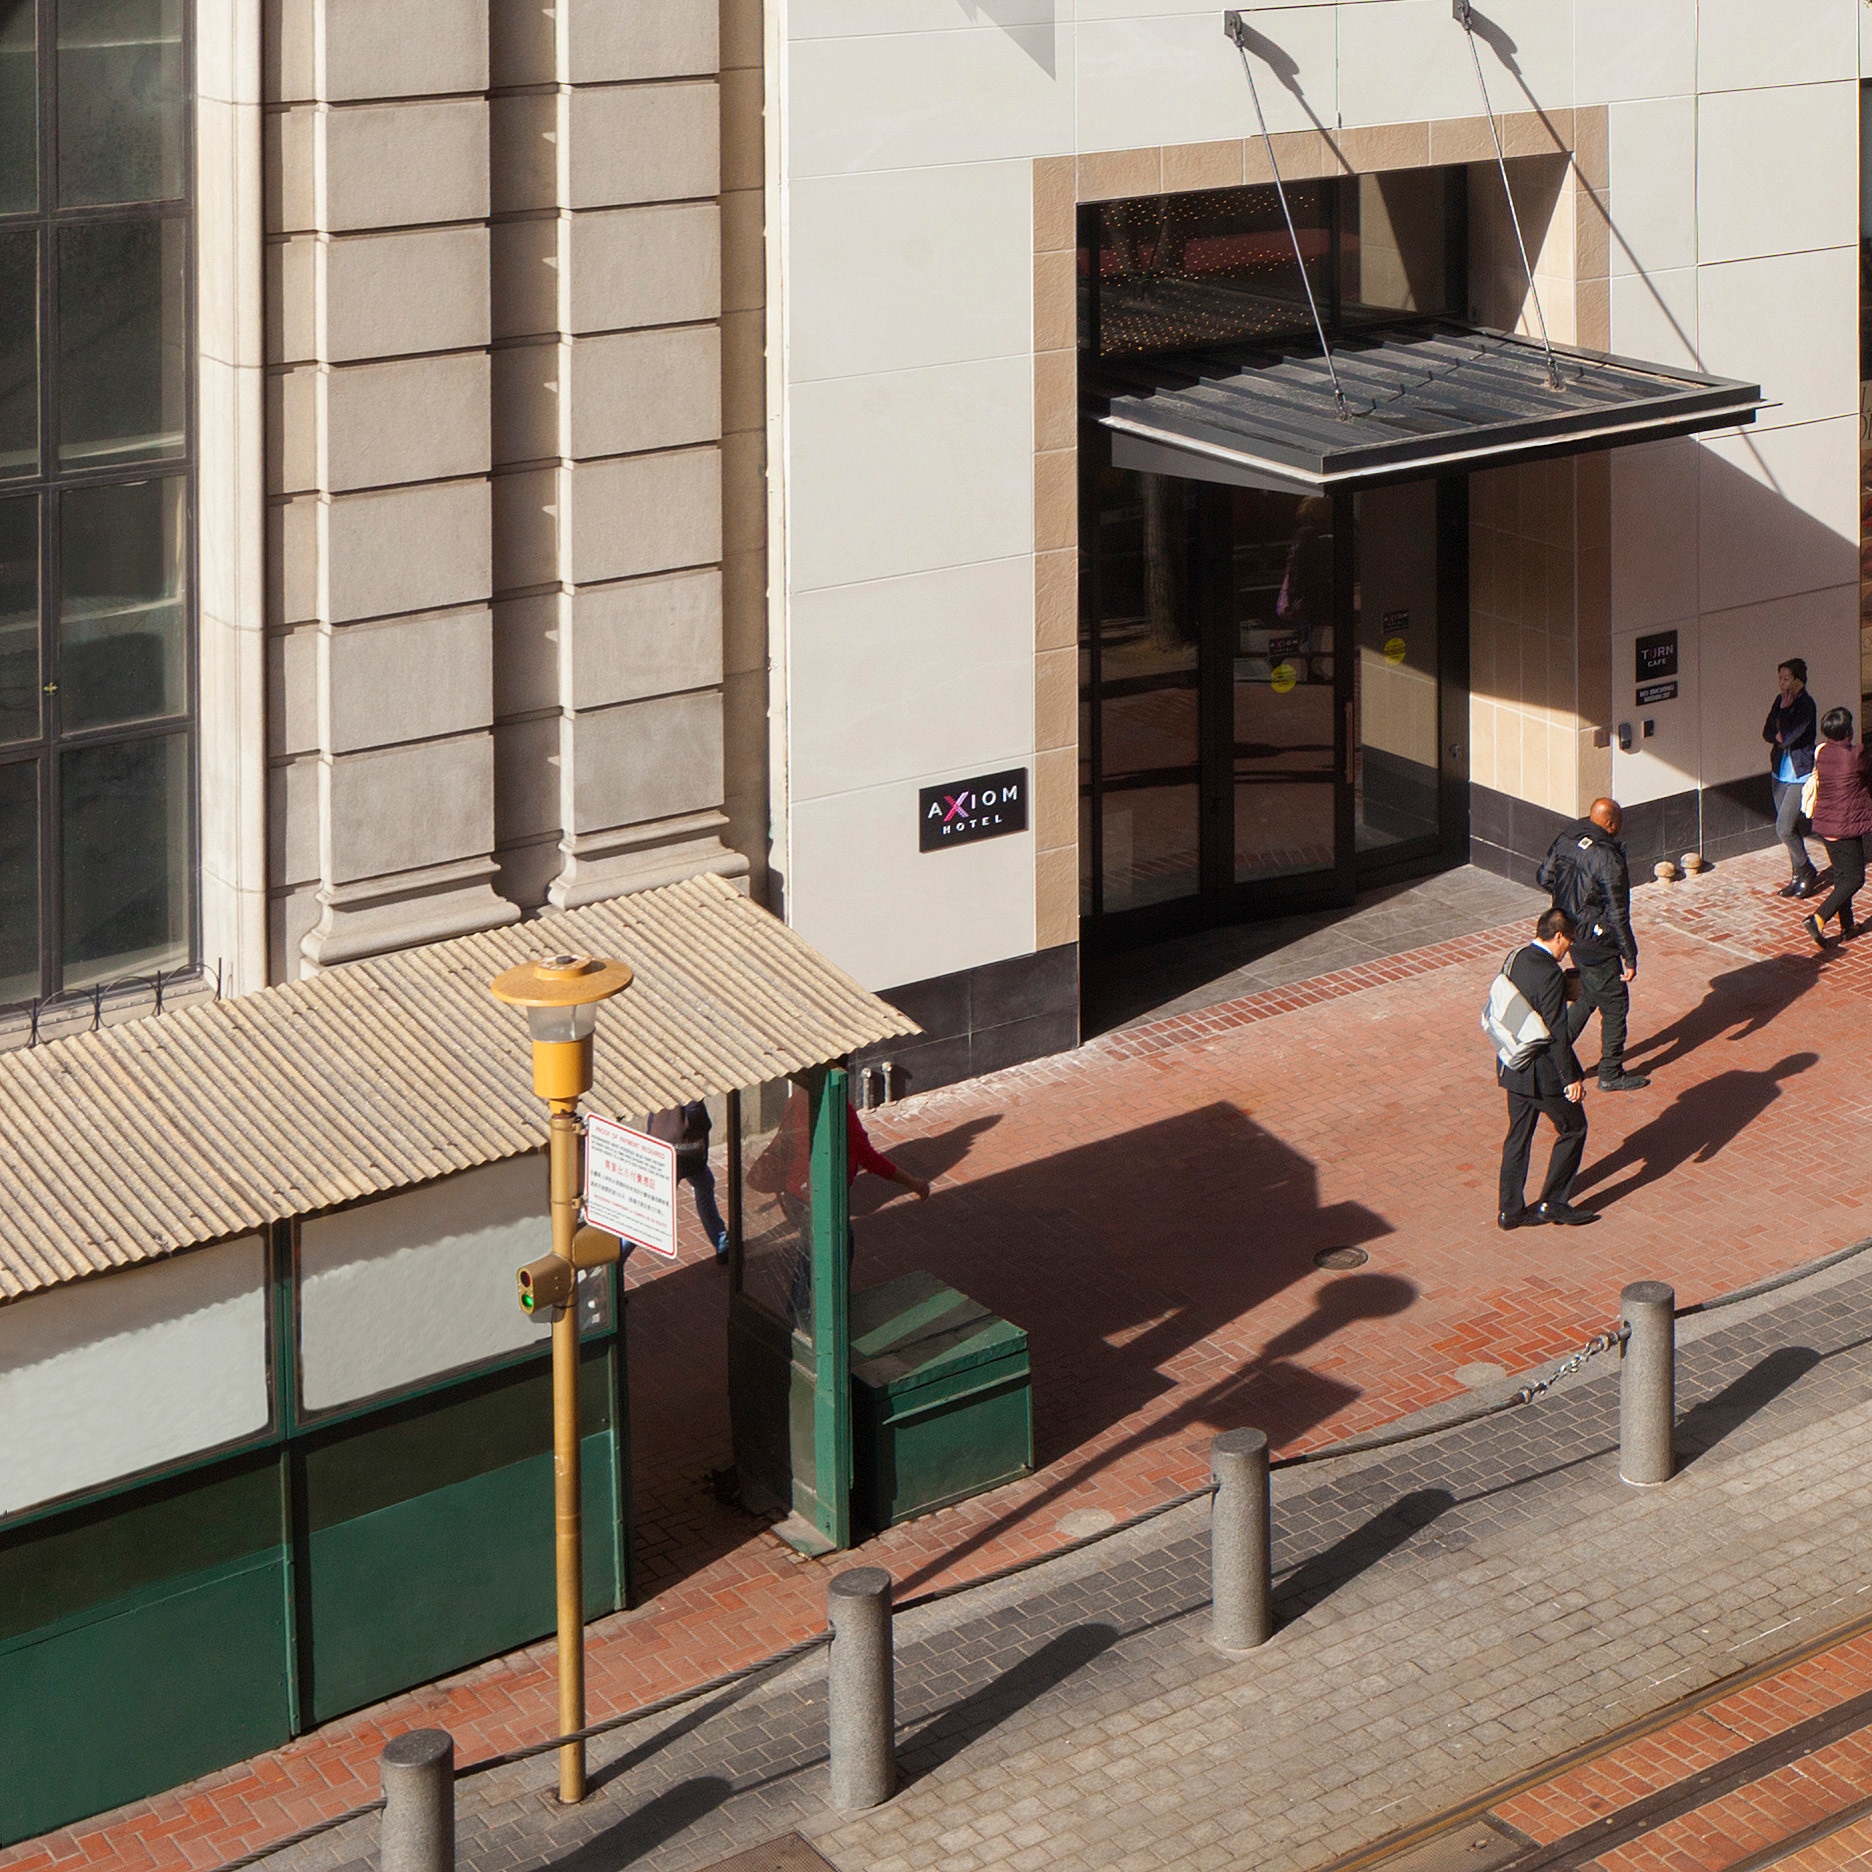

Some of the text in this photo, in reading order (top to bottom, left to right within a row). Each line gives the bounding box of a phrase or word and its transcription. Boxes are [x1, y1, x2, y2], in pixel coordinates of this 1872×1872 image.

[1641, 644, 1674, 660] TURN
[1647, 658, 1667, 668] CAFE
[927, 785, 1018, 822] AXIOM
[942, 814, 1003, 835] HOTEL
